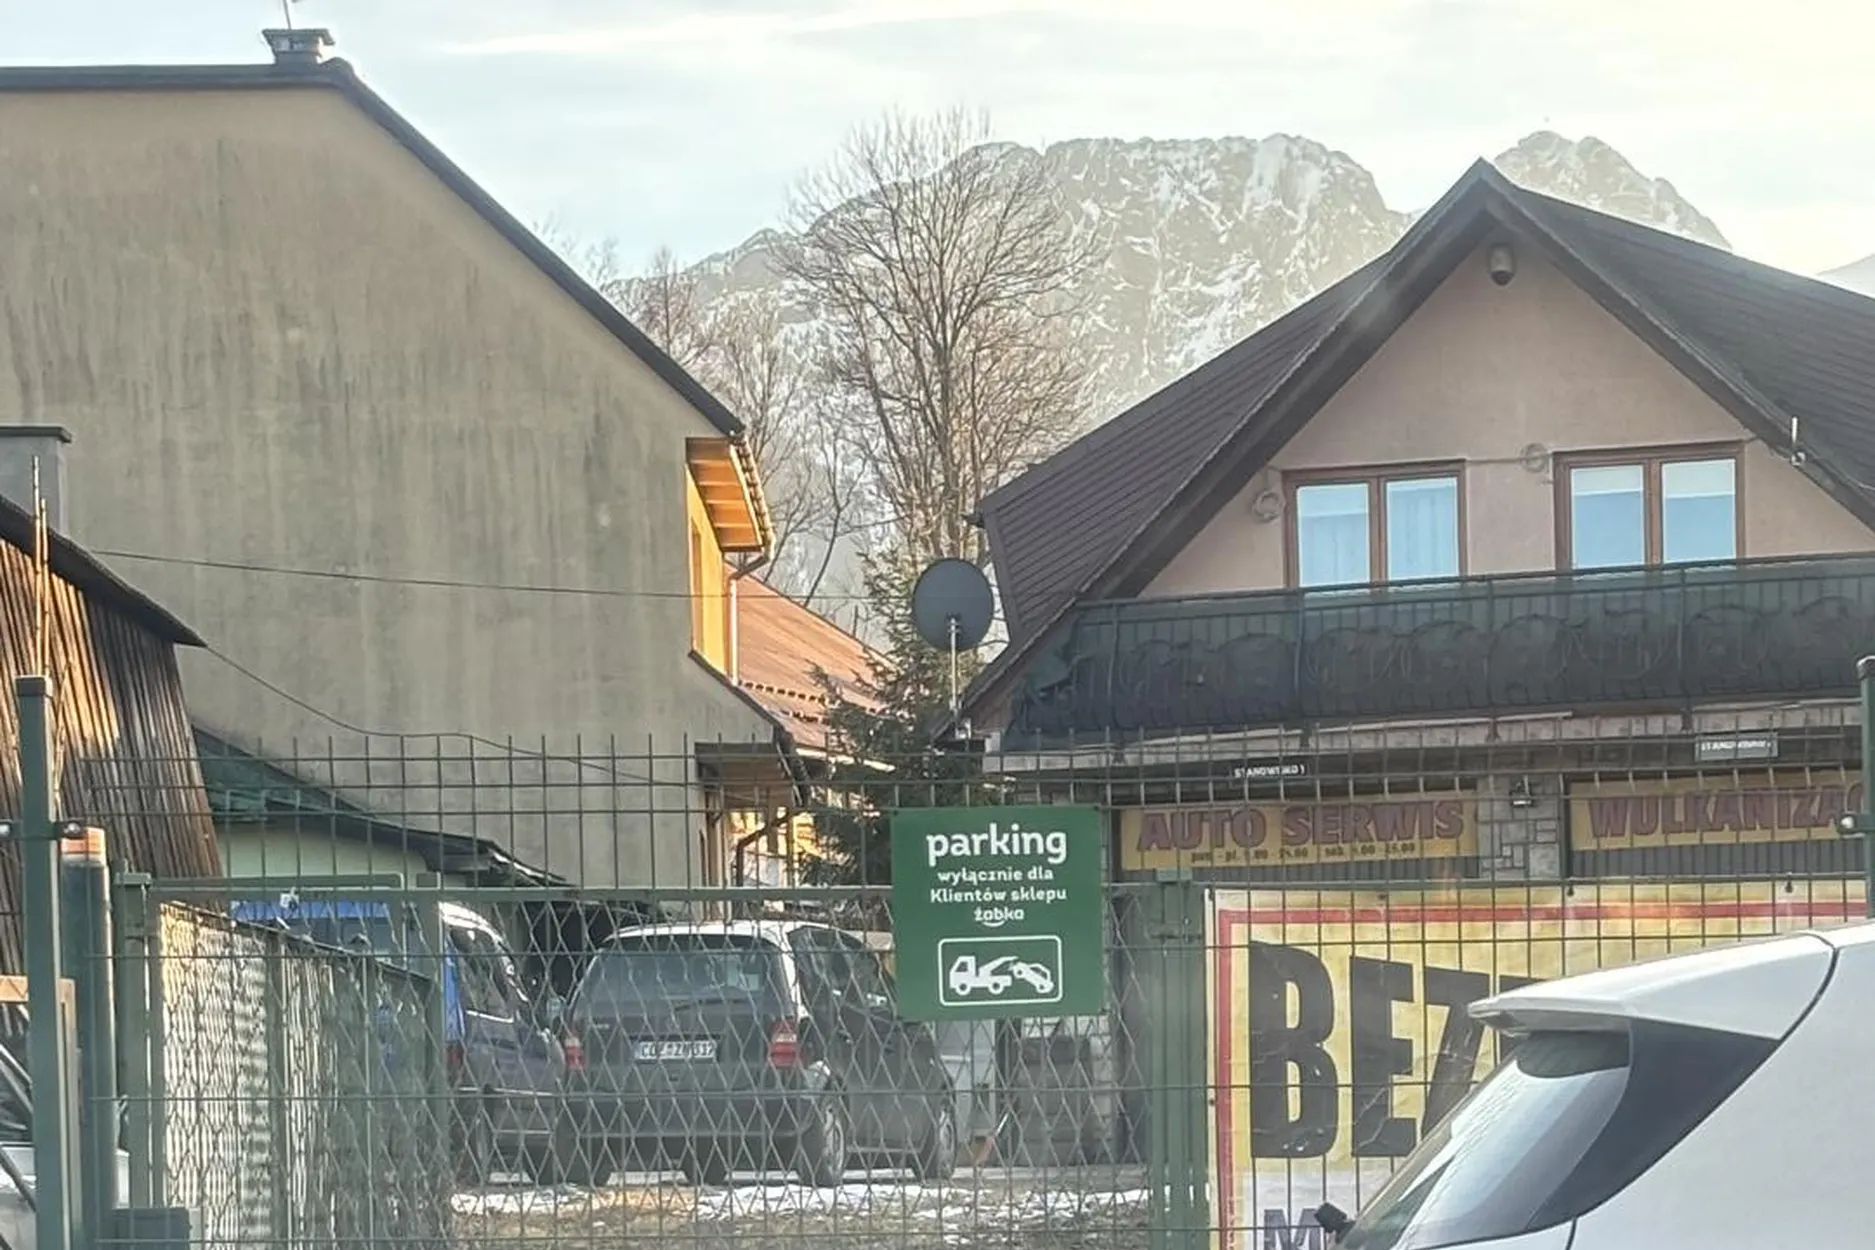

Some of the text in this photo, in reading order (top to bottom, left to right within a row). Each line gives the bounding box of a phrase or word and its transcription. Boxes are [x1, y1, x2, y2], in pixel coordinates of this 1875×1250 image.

[1137, 801, 1465, 850] AUTO SERWIS
[926, 823, 1067, 867] parking
[937, 866, 1054, 886] wyłącznie dla
[930, 887, 1067, 903] Klientów sklepu
[973, 907, 1025, 922] żabka
[1249, 941, 1545, 1158] BEZ
